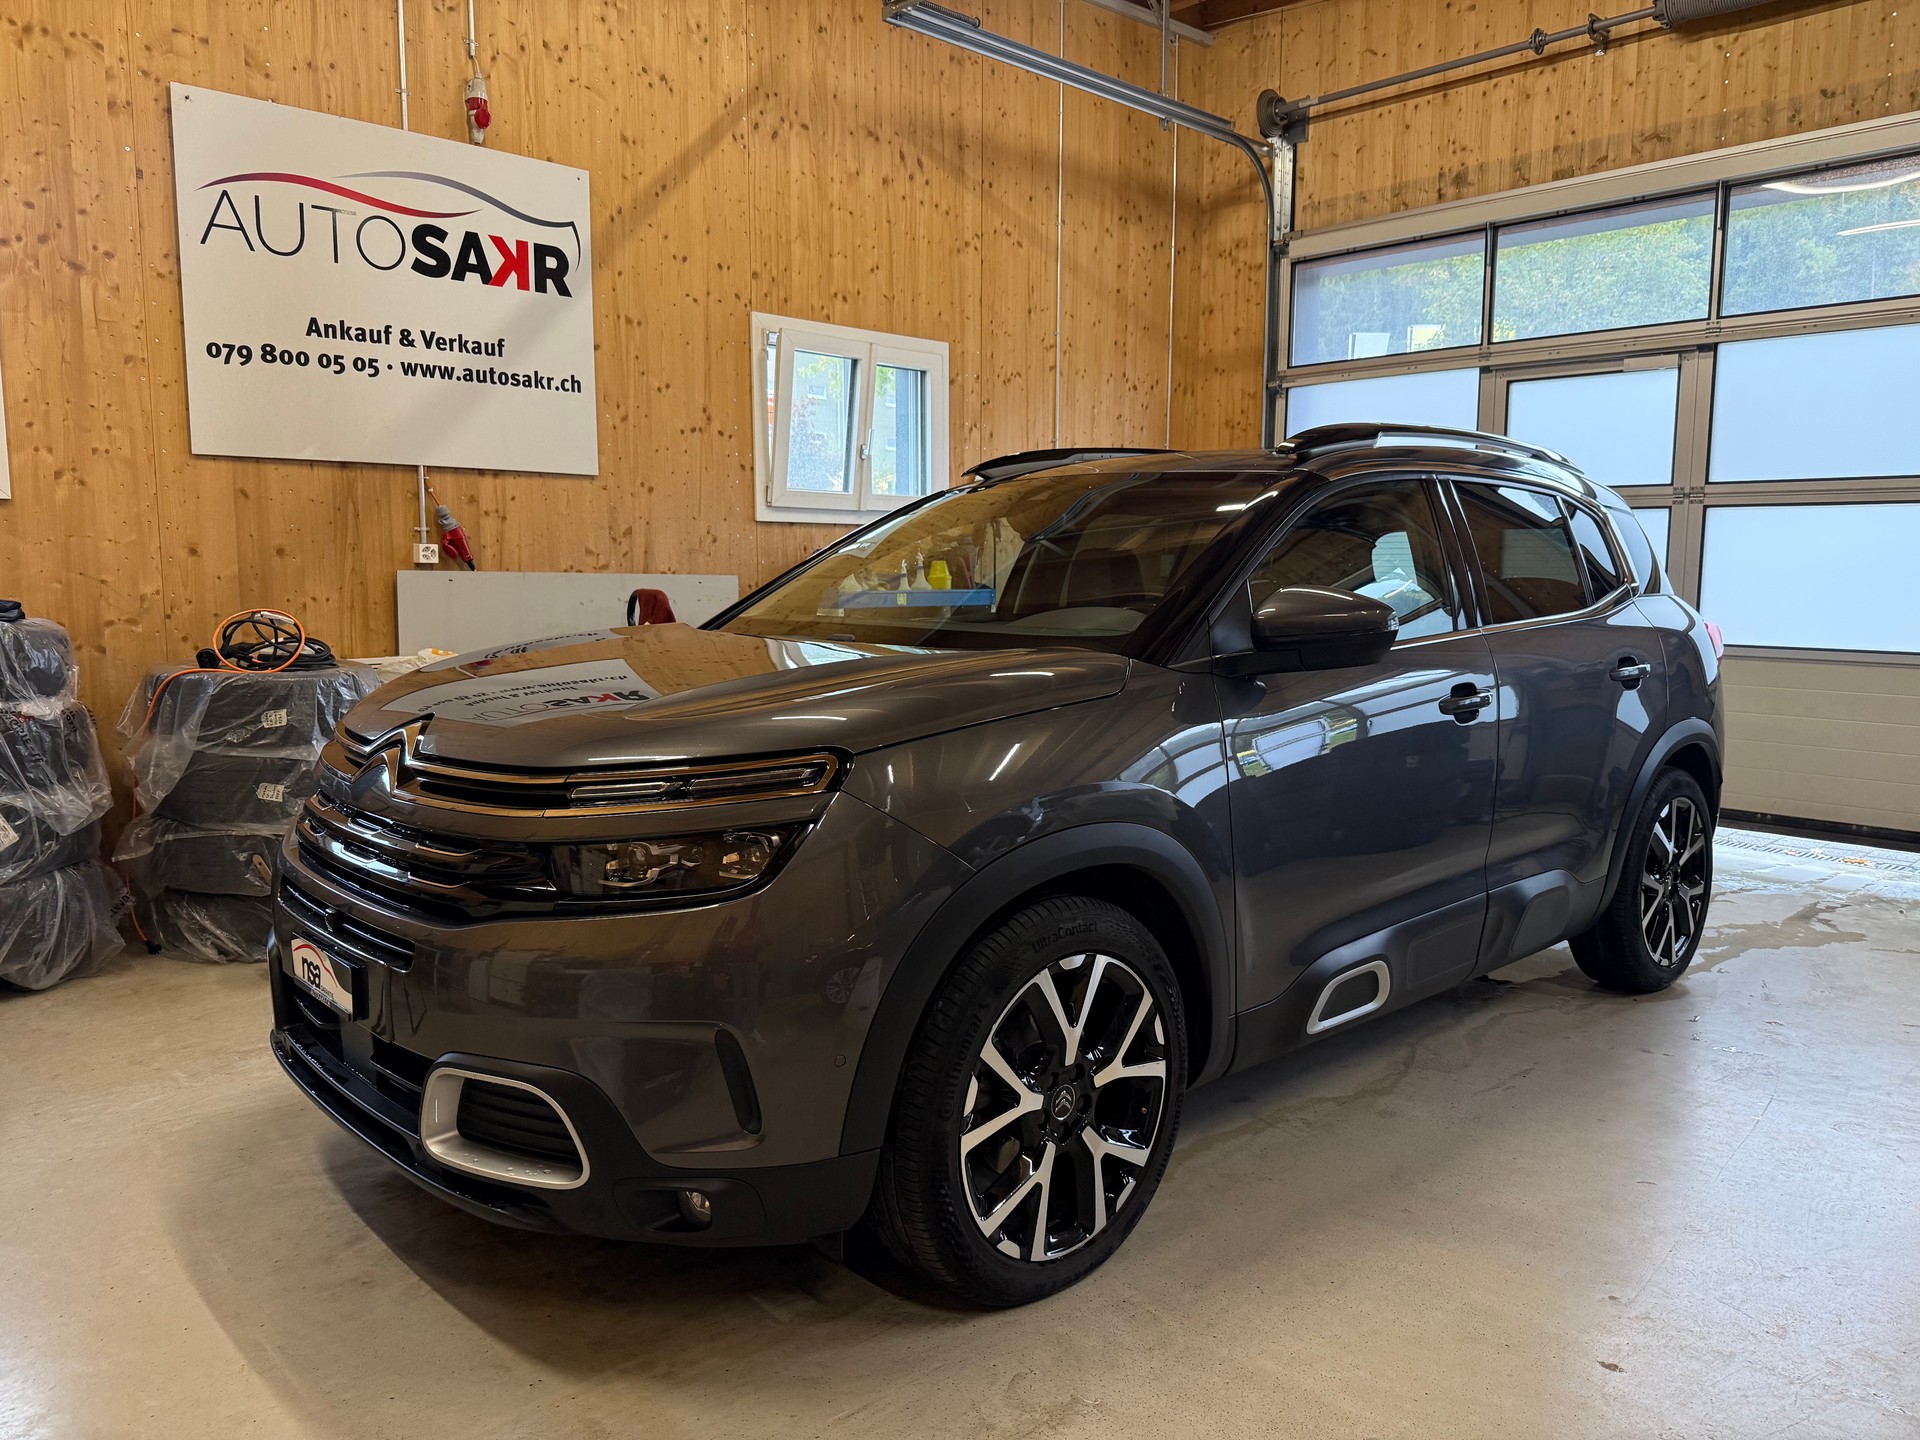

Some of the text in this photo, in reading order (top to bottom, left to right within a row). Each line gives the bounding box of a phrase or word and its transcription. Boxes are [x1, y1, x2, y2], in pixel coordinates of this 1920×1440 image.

[200, 189, 573, 298] AUTOSAKR
[305, 317, 505, 357] Ankauf & Verkauf
[206, 341, 253, 366] 079
[260, 343, 310, 367] 800
[318, 355, 346, 375] 05
[352, 356, 380, 377] 05
[400, 359, 582, 393] www.autosakr.ch
[1031, 920, 1098, 954] UltraContact
[301, 956, 321, 990] nsa
